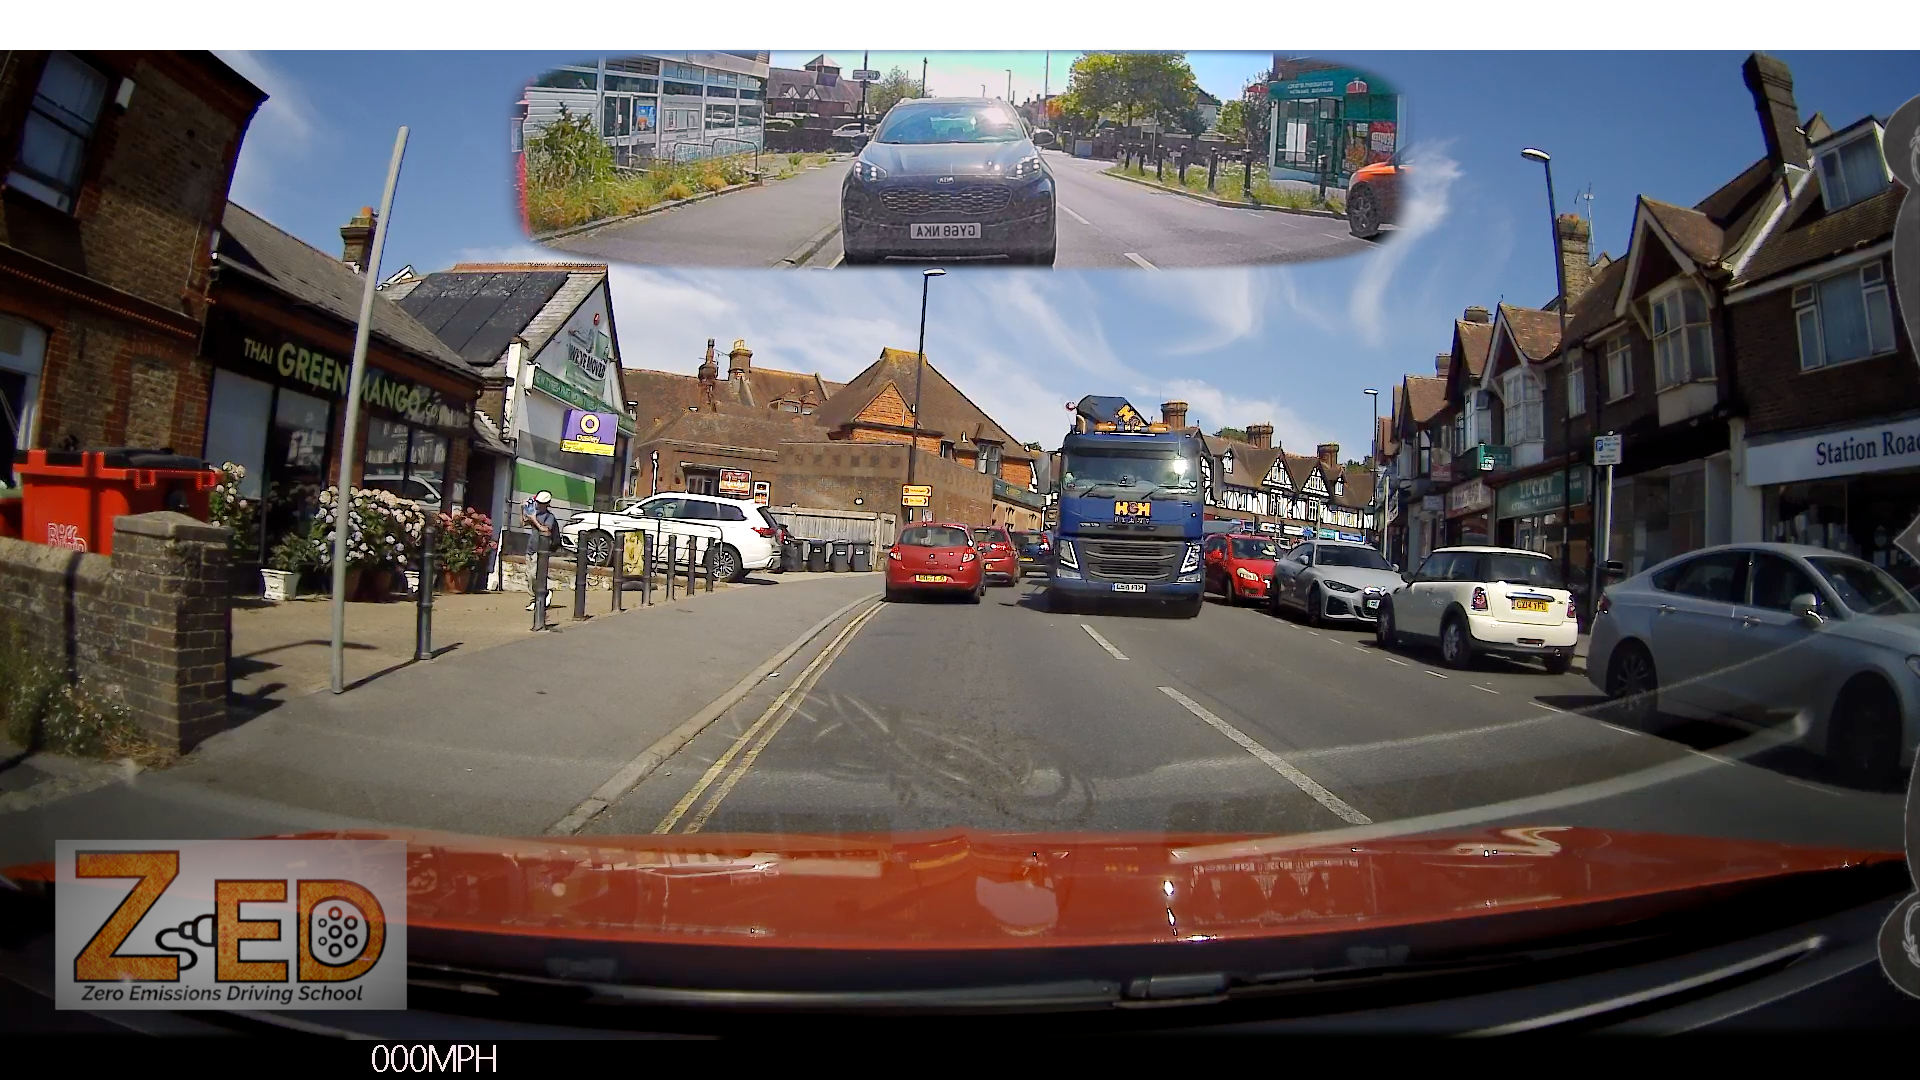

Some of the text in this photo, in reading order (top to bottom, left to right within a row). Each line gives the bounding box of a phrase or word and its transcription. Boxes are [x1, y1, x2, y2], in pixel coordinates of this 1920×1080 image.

[244, 338, 273, 364] THAI
[277, 342, 350, 397] GREEN
[1816, 437, 1877, 466] Station
[1520, 476, 1554, 499] LUCKY
